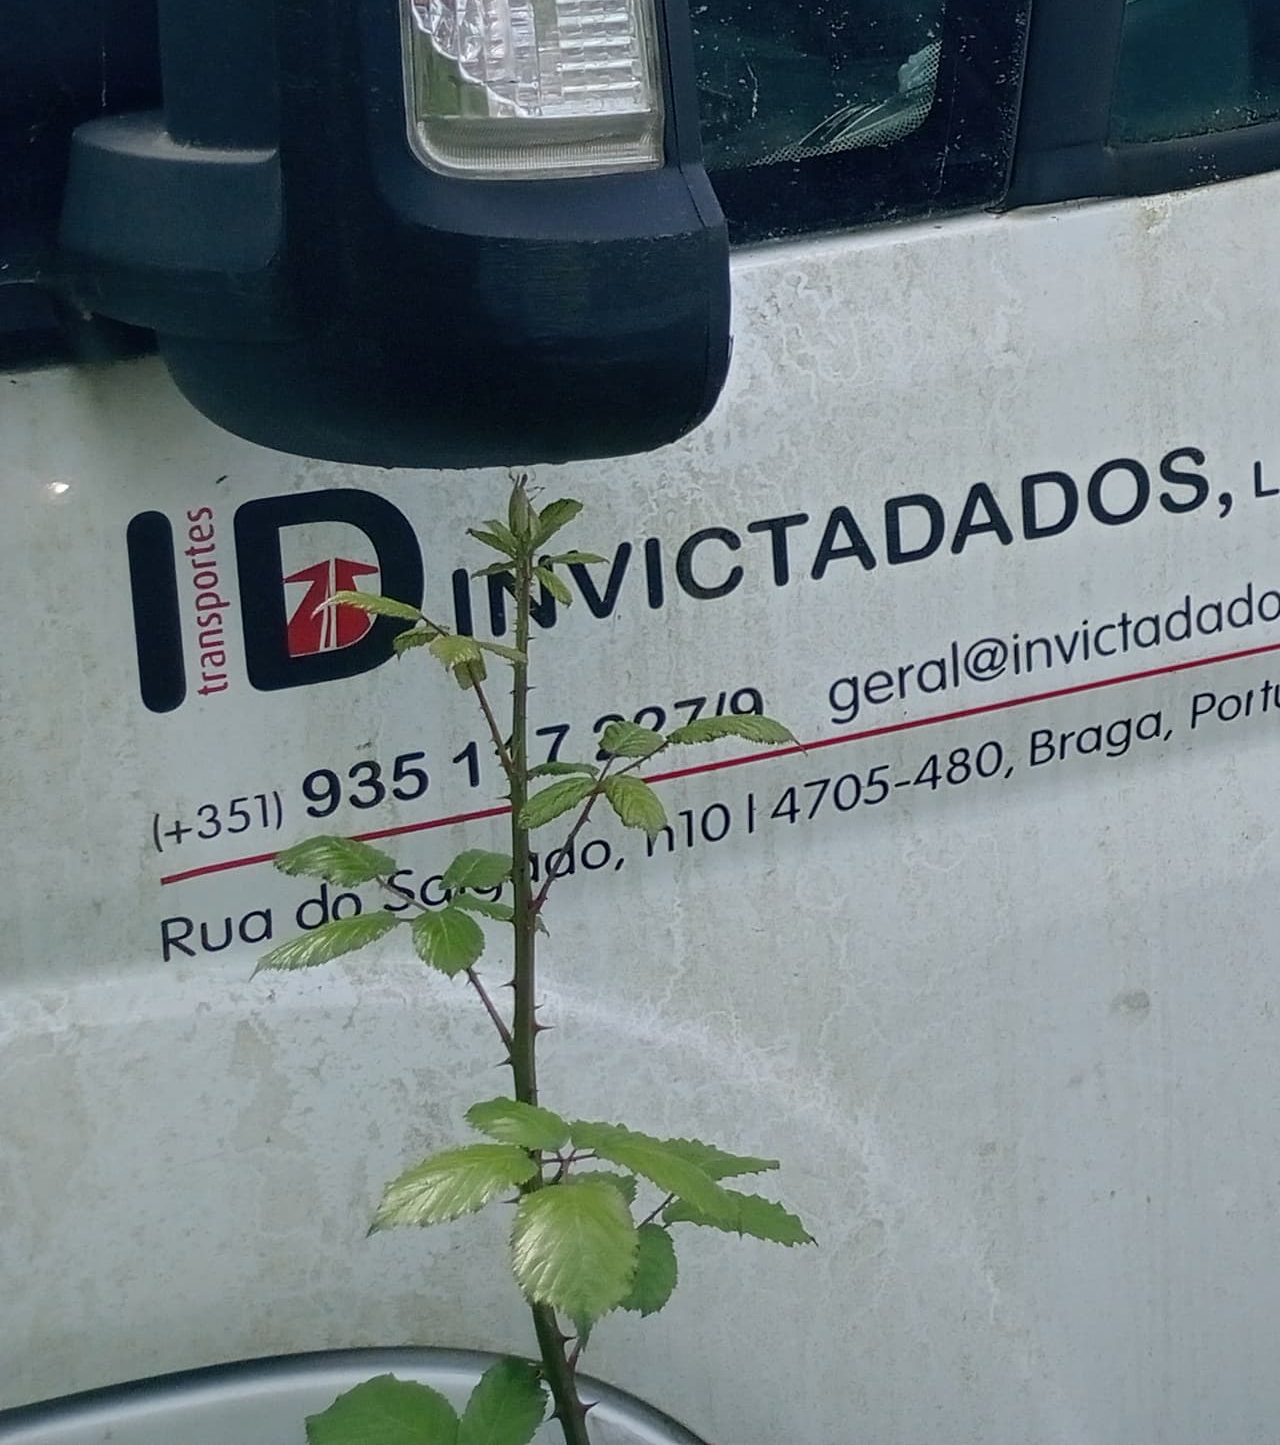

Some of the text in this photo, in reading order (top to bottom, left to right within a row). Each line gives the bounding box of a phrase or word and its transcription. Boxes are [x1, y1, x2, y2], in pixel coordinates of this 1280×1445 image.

[186, 506, 230, 696] transportes
[452, 446, 1233, 638] INVICTADADOS,
[152, 791, 284, 853] (+351)
[302, 754, 428, 818] 935
[452, 723, 571, 788] 17
[160, 909, 273, 961] Rua
[295, 883, 362, 930] do
[770, 741, 1016, 826] 4705-480,
[1028, 711, 1173, 767] Braga,
